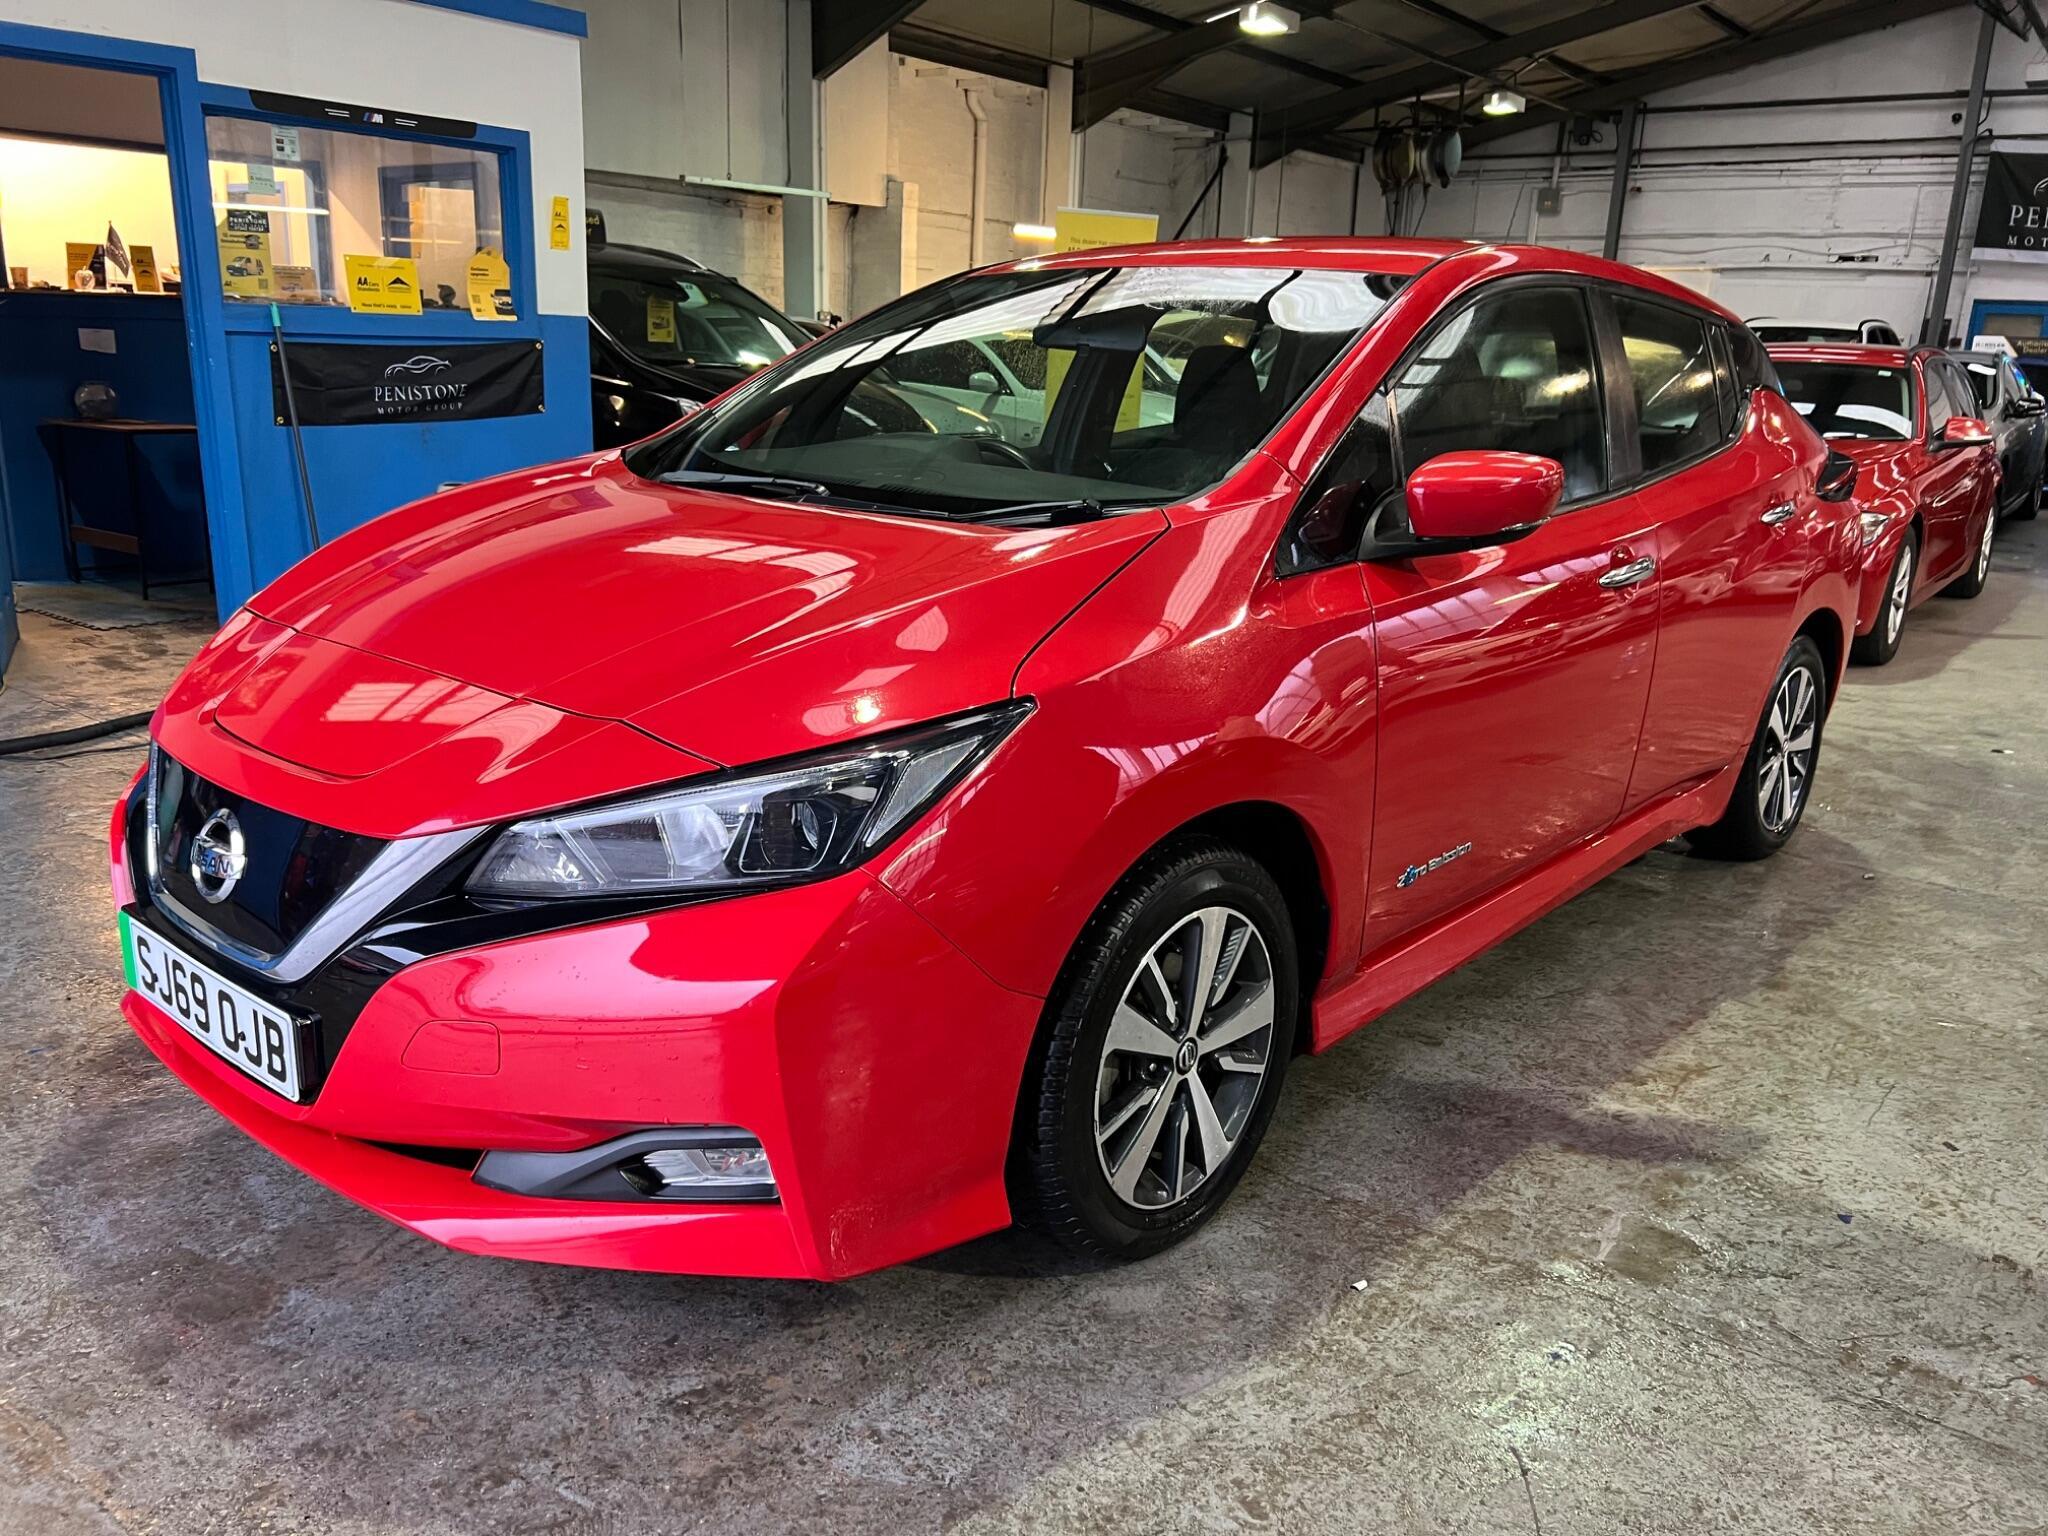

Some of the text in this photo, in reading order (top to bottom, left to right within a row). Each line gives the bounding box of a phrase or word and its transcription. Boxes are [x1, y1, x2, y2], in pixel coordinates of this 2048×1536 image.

[374, 383, 468, 403] PENISTONE
[377, 402, 463, 415] MOTOR GROUP
[136, 934, 211, 1034] SJ69
